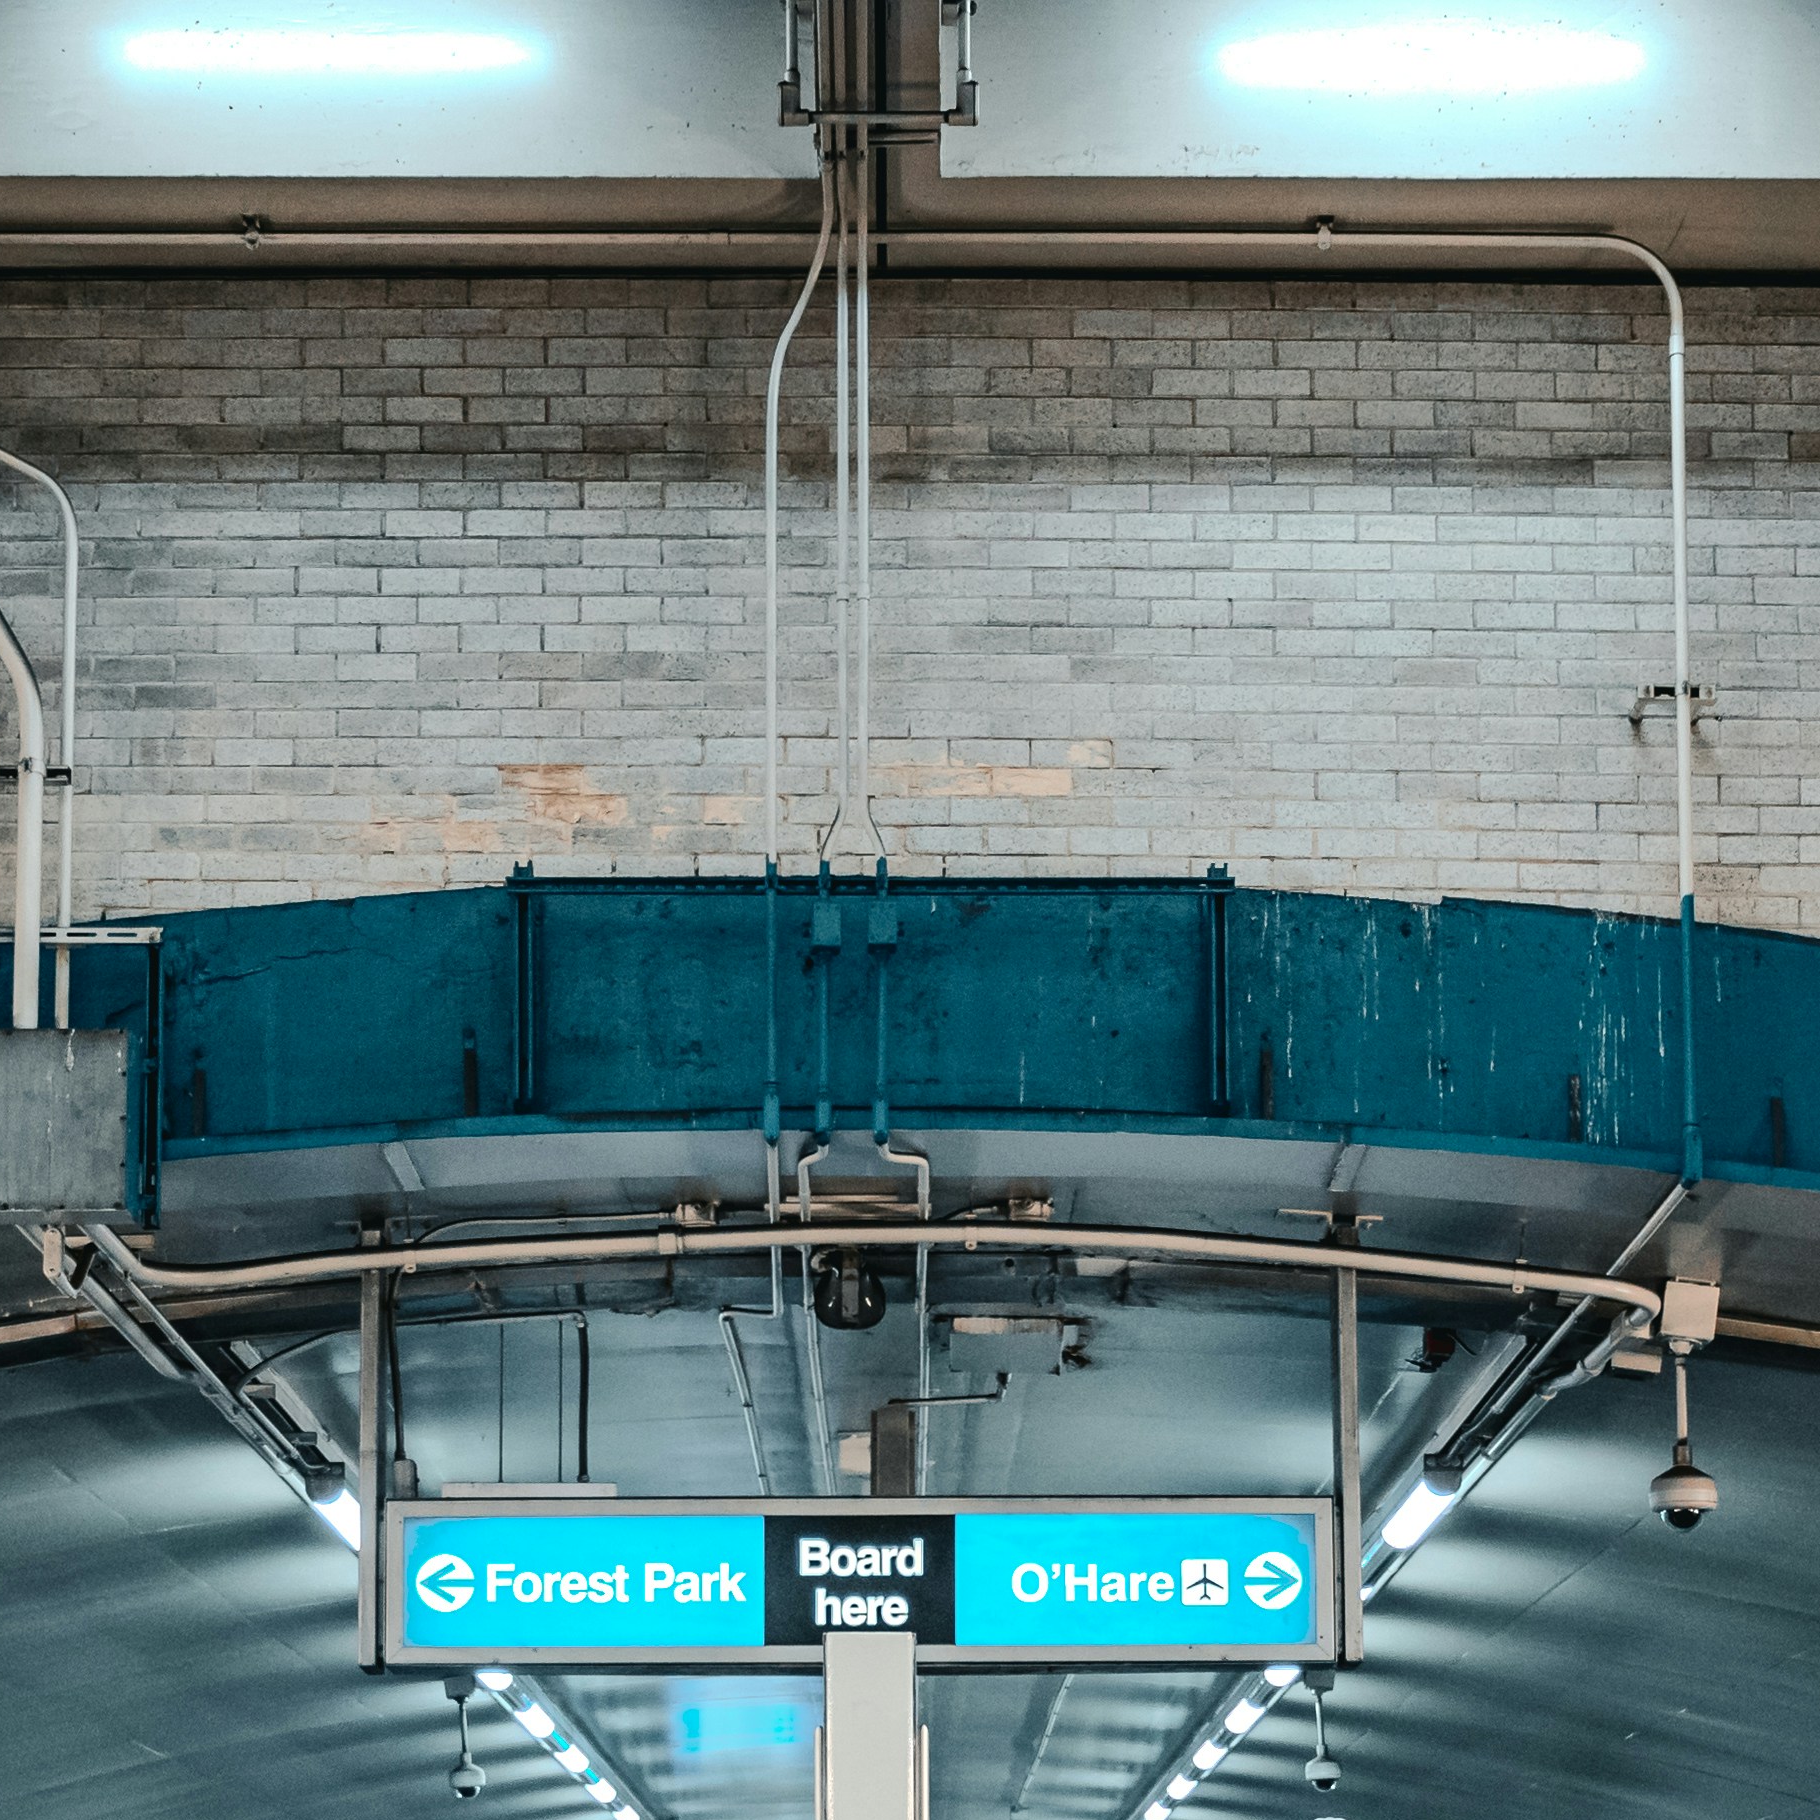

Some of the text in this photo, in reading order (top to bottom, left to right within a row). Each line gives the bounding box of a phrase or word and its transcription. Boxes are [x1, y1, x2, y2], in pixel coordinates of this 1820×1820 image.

[798, 1537, 923, 1577] Board
[485, 1562, 747, 1604] Forest Park
[1011, 1563, 1173, 1603] O'Hare
[814, 1588, 908, 1626] here
